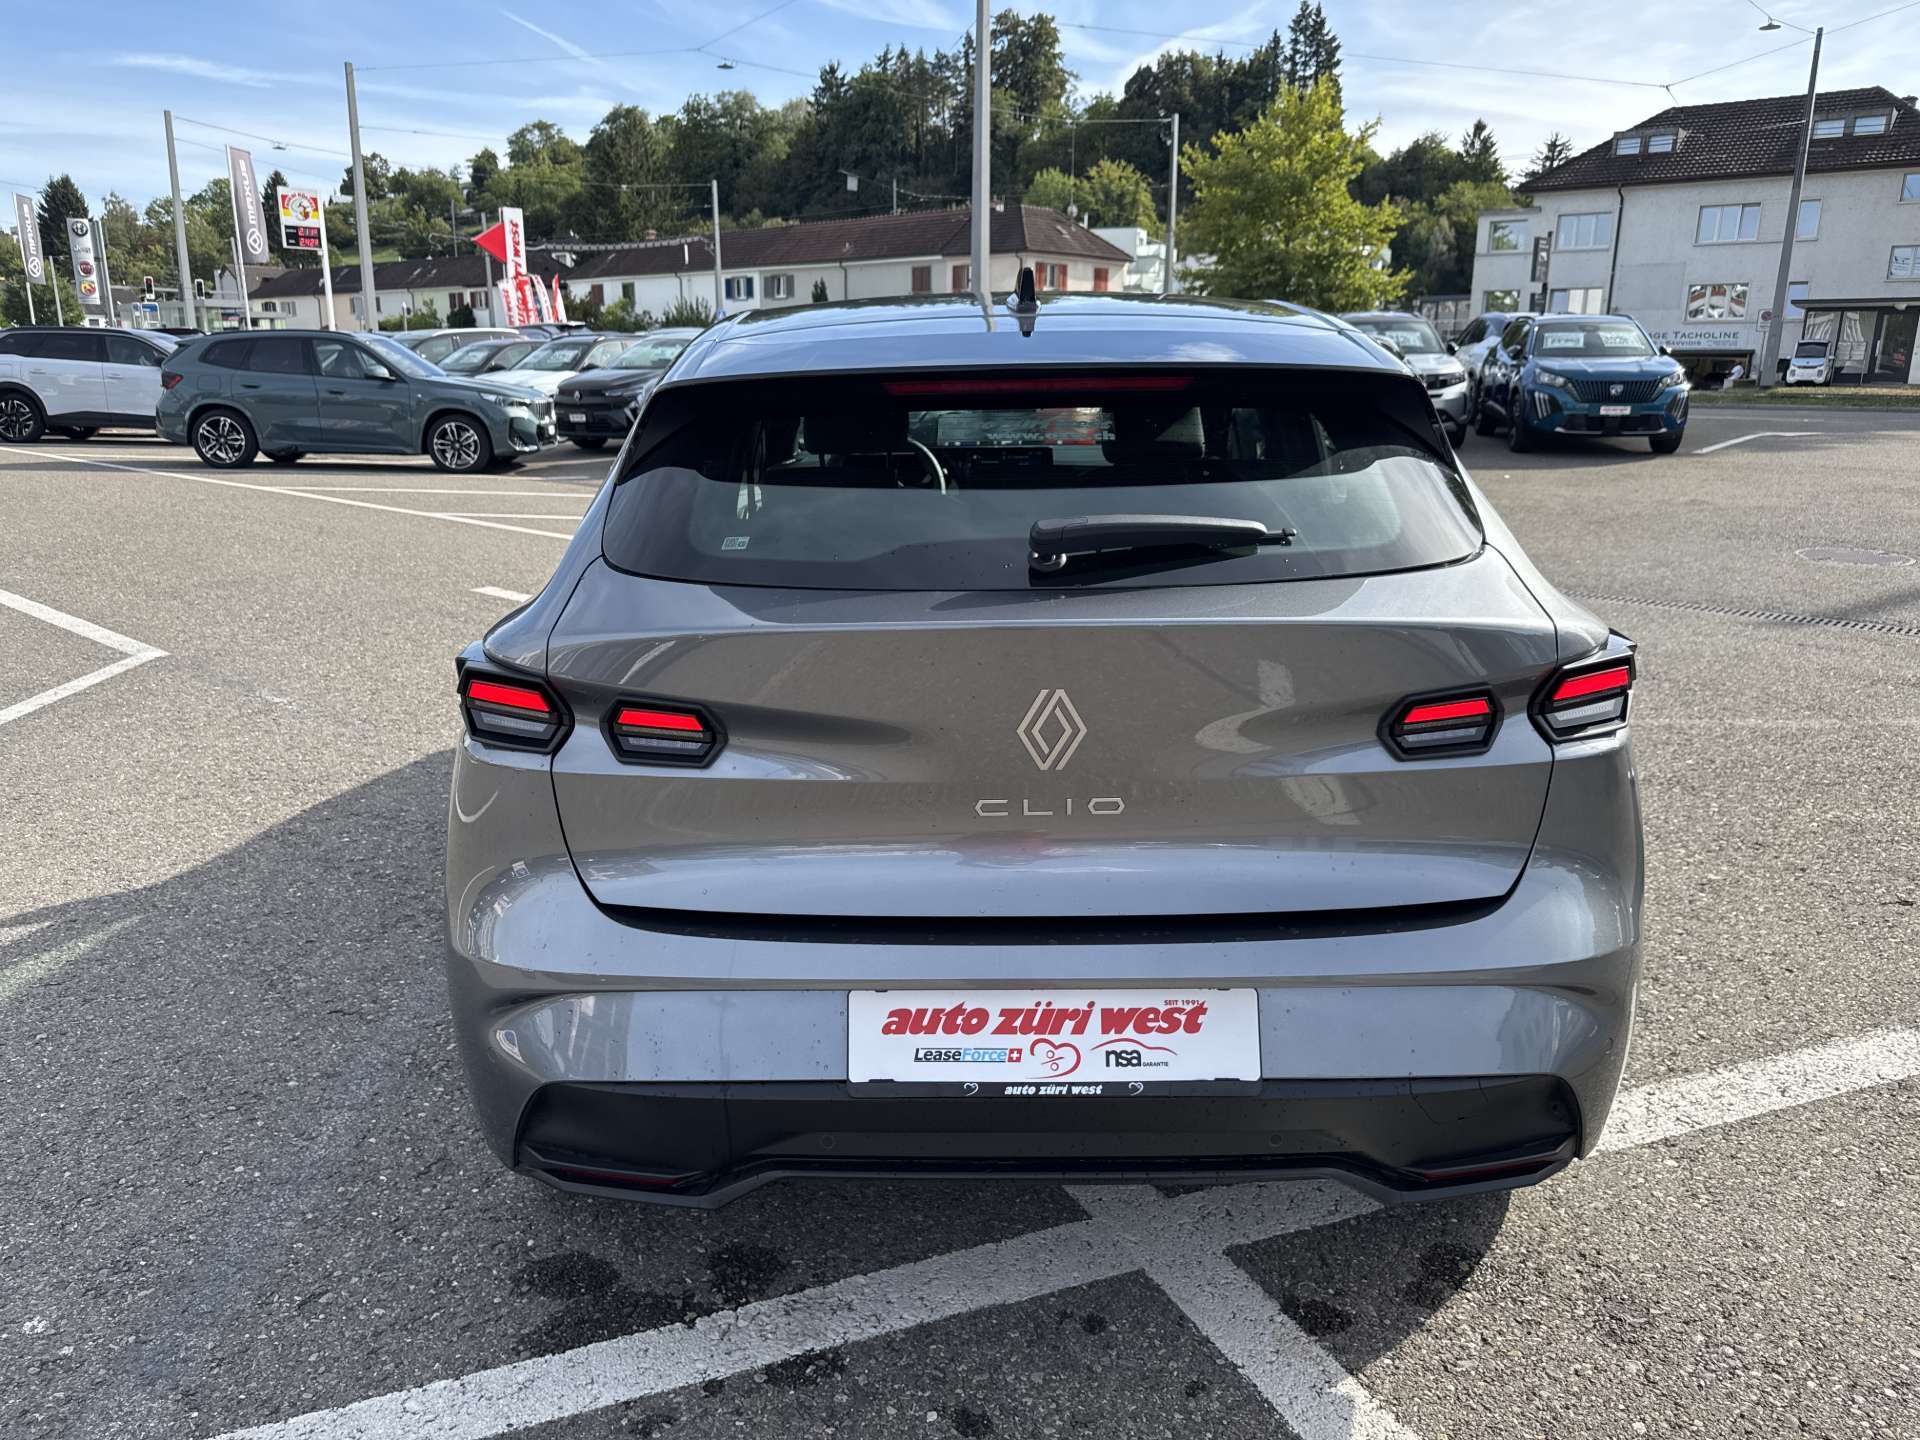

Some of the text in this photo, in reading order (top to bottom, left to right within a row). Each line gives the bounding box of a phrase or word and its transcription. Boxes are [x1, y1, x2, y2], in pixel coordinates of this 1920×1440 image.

[975, 798, 1125, 816] CLIO
[881, 1000, 1208, 1035] auto züri west
[914, 1048, 1007, 1062] LeaseForce
[1105, 1050, 1142, 1067] nsa
[1004, 1084, 1103, 1095] auto züri west
